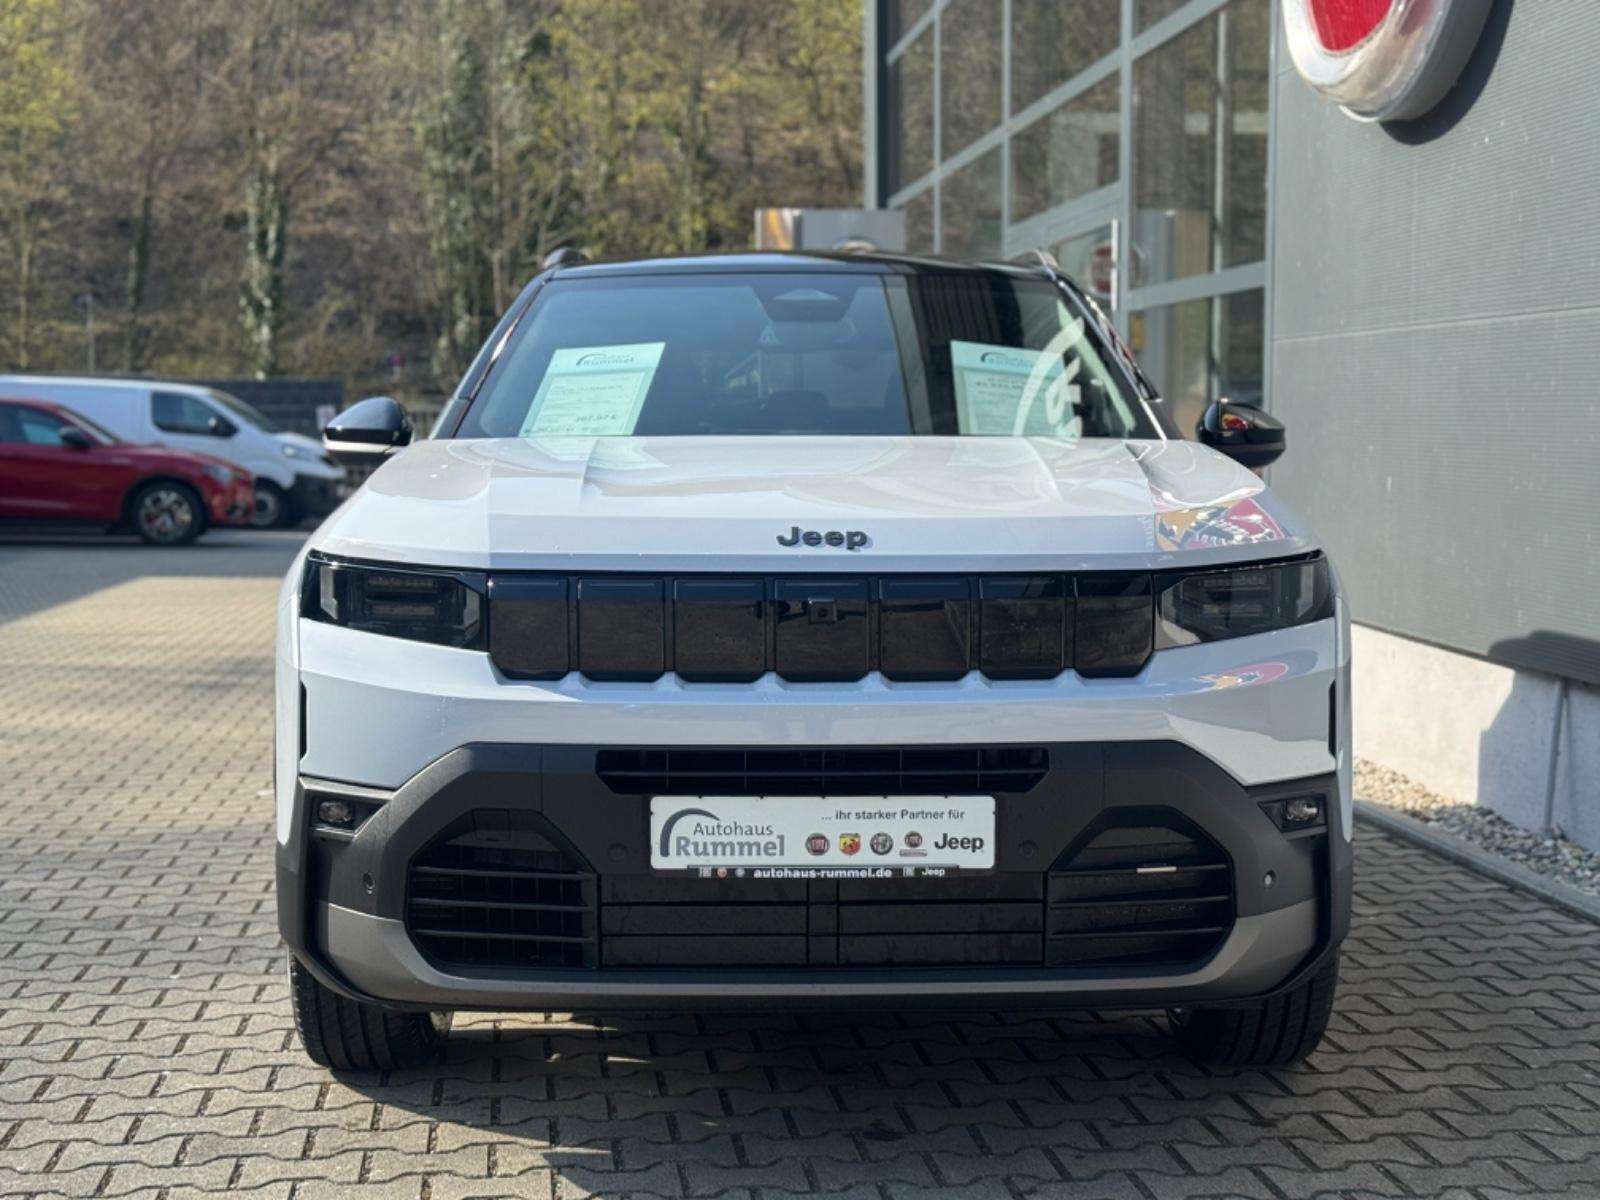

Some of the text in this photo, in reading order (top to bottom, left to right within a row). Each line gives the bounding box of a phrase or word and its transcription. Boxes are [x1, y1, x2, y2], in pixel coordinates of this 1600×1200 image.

[776, 526, 868, 550] Jeep
[835, 809, 852, 820] ihr
[854, 809, 897, 820] starker
[900, 809, 945, 820] Partner
[948, 808, 966, 820] für
[693, 821, 774, 836] Autohaus
[675, 834, 785, 857] Rummel
[934, 833, 984, 853] Jeep
[753, 867, 893, 879] autohaus-rummel.de
[922, 867, 946, 877] Jeep
